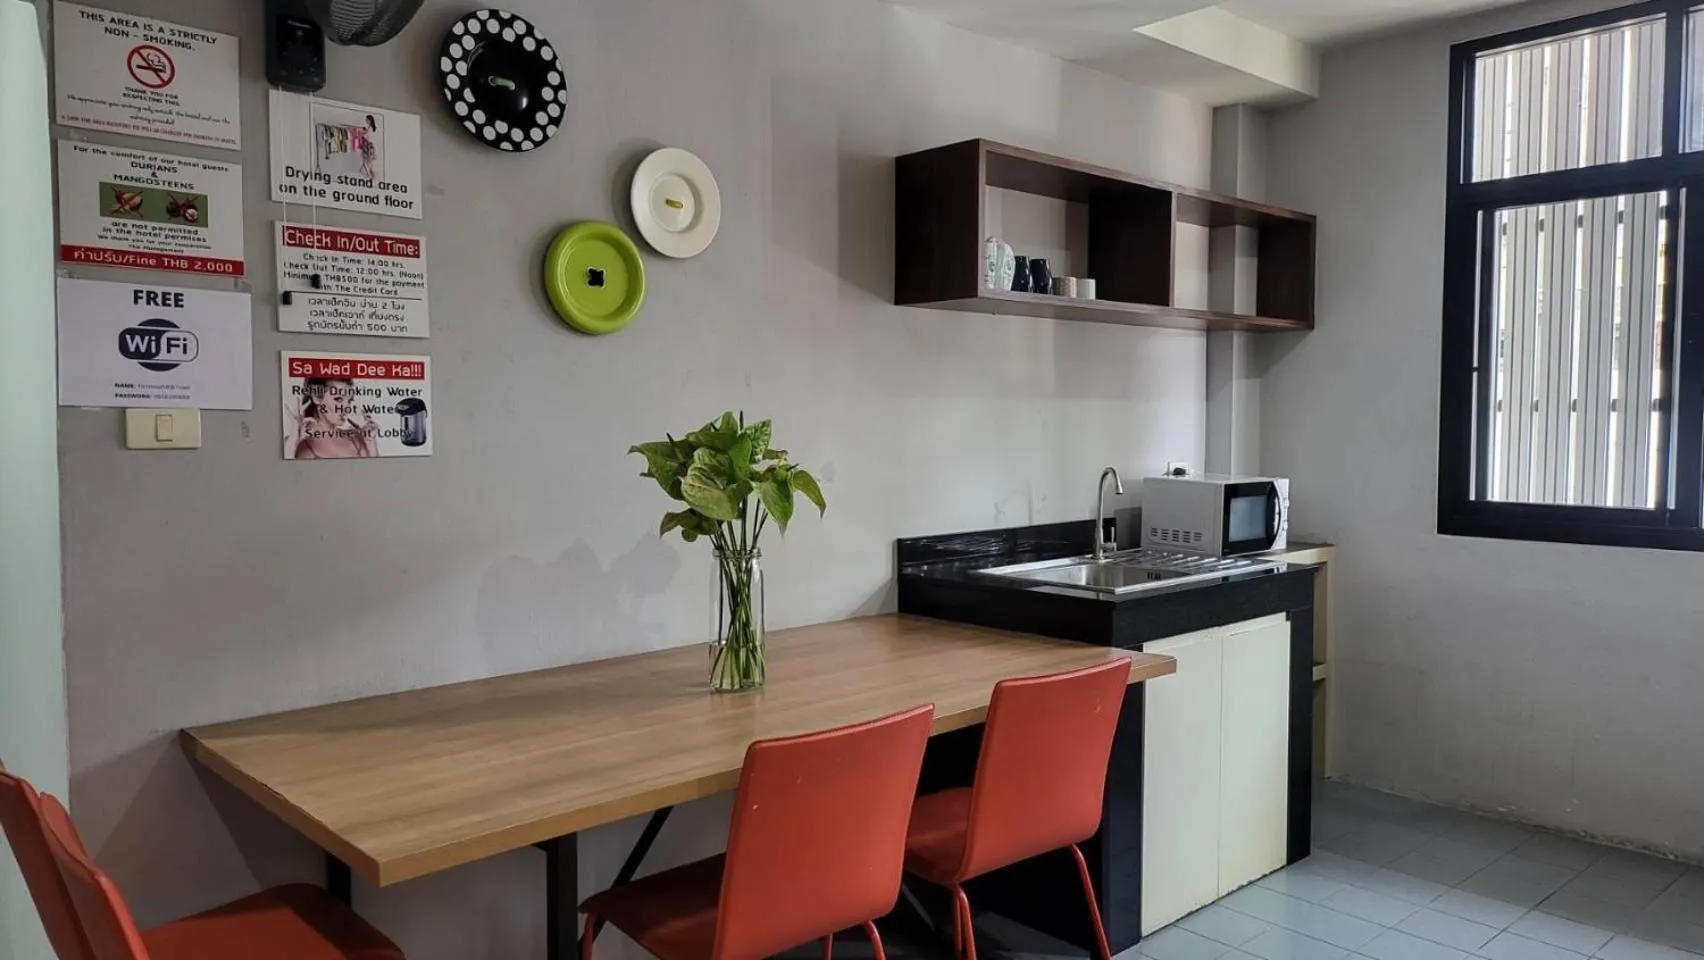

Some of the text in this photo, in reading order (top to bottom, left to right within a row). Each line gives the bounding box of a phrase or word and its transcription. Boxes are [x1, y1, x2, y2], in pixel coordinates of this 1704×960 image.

[79, 10, 218, 44] THIS AREA IS A STRICTLY
[104, 26, 130, 38] NON
[73, 145, 89, 153] For
[92, 147, 107, 155] the
[110, 150, 145, 160] comfort
[149, 155, 158, 163] of
[178, 159, 200, 168] hotel
[202, 163, 229, 173] guests
[130, 160, 178, 174] DURIANS
[113, 173, 194, 190] MANGOSTEENS
[151, 171, 158, 179] &
[285, 166, 408, 194] Drying stand area
[279, 184, 414, 209] on the ground floor
[102, 226, 111, 234] in
[115, 227, 132, 236] the
[135, 229, 162, 240] hotel
[111, 220, 199, 236] are not permitted
[285, 229, 419, 256] Check In/Out Time:
[163, 256, 189, 270] THB
[331, 256, 339, 264] In
[356, 267, 379, 276] 12:00
[283, 271, 320, 282] Minim
[361, 276, 373, 284] for
[376, 278, 389, 286] the
[392, 279, 425, 289] payment
[336, 284, 351, 293] The
[353, 285, 377, 294] Credit
[380, 286, 398, 295] Card
[133, 289, 185, 308] FREE
[367, 323, 387, 332] 500
[292, 361, 313, 374] Sa
[320, 362, 351, 375] Wad
[357, 363, 386, 376] Dee
[330, 385, 382, 398] Drinking
[386, 386, 422, 397] Water
[319, 404, 398, 414] & Hot Wate
